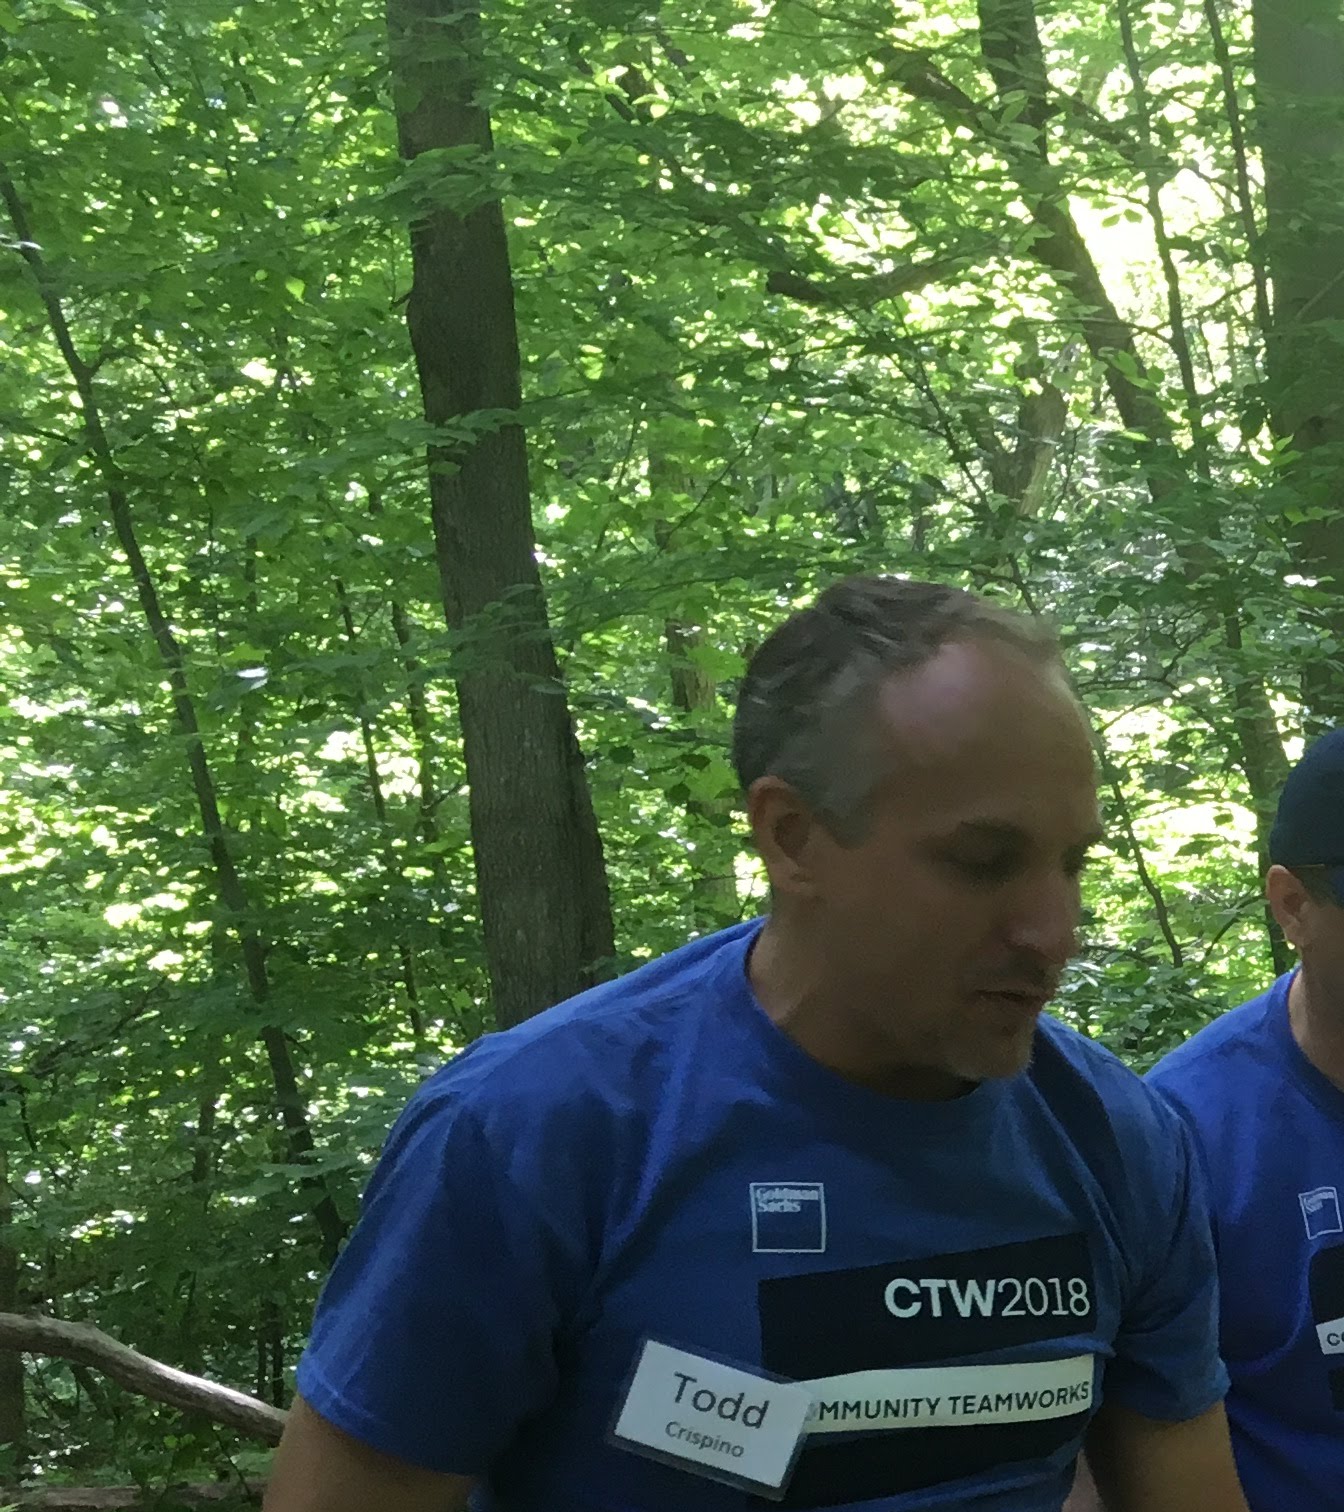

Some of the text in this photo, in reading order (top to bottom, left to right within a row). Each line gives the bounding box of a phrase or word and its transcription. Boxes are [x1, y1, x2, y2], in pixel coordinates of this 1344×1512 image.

[884, 1277, 1090, 1318] CTW2018
[674, 1371, 770, 1429] Todd
[806, 1381, 1090, 1421] MMUNITY TEAMWORKS
[665, 1420, 744, 1458] Crispino
